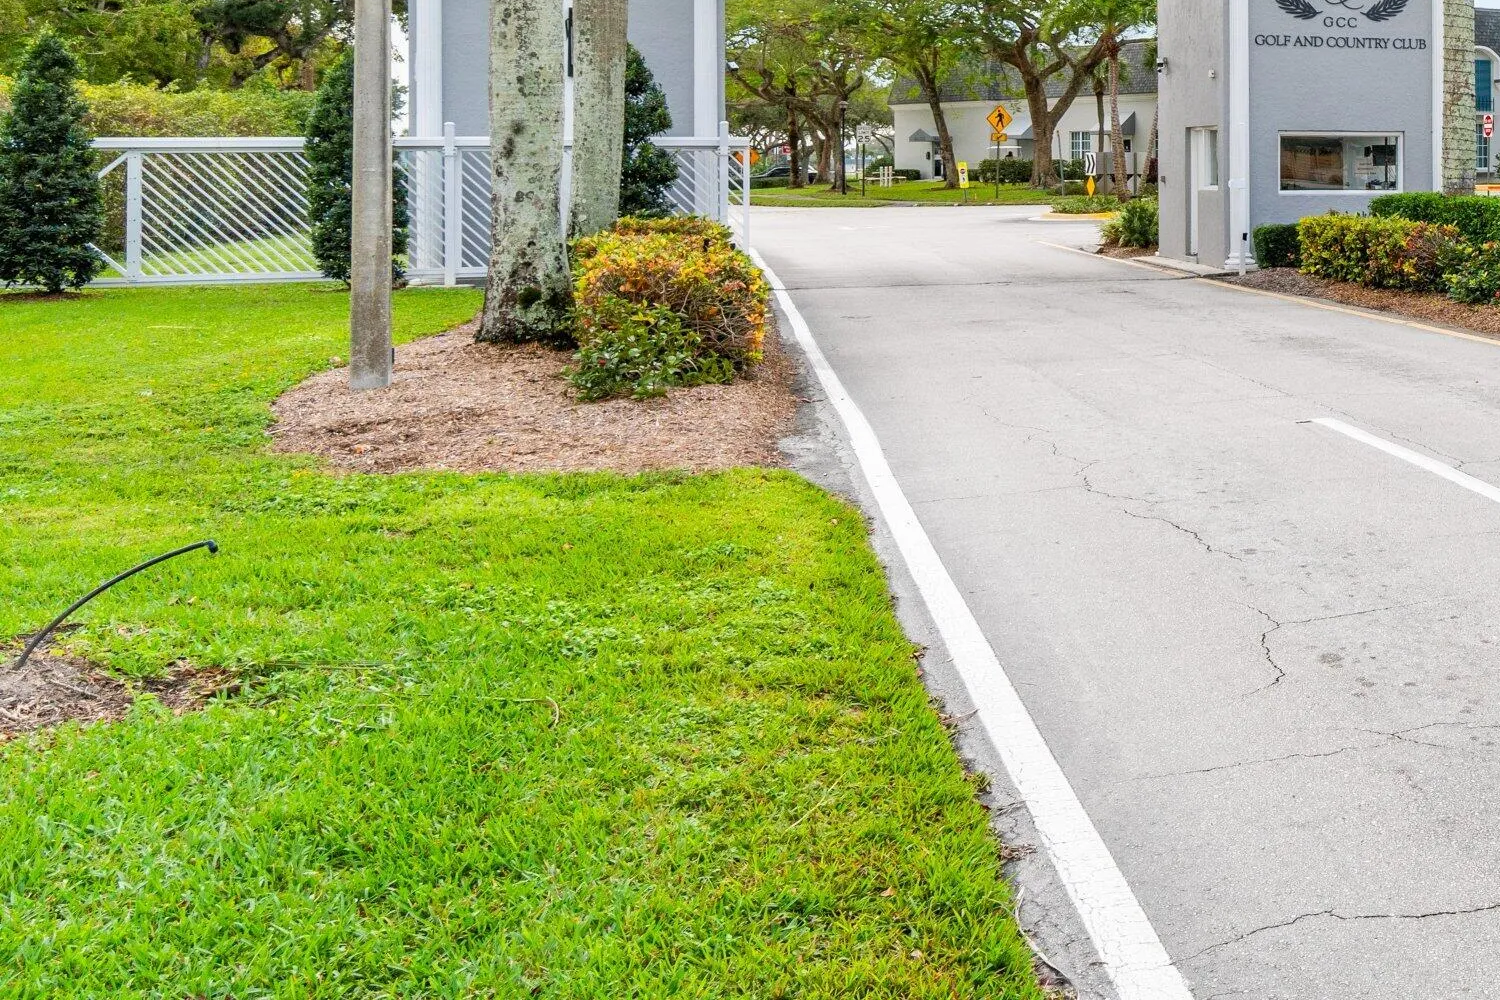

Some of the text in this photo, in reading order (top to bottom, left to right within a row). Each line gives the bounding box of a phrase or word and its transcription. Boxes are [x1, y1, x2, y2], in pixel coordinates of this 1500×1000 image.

[1323, 16, 1358, 28] GCC
[1254, 34, 1427, 50] GOLF AND COUNTRY CLUB
[857, 135, 871, 143] 25
